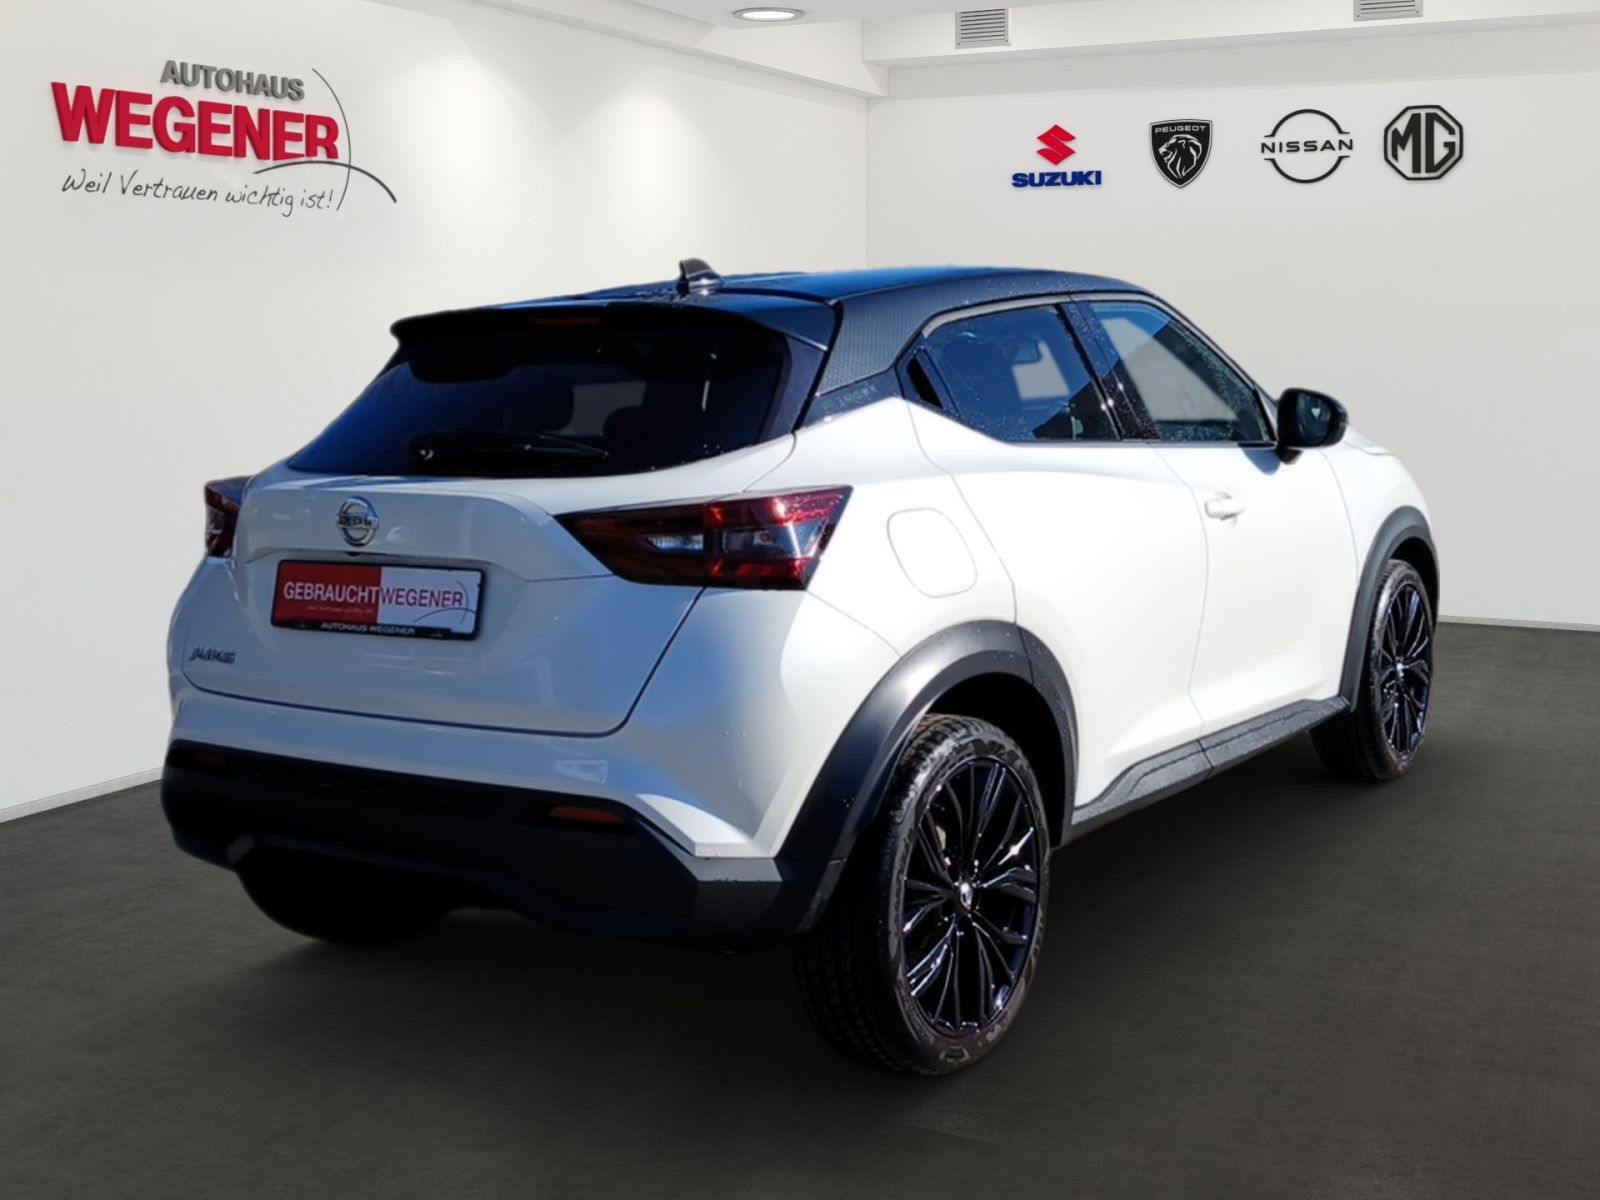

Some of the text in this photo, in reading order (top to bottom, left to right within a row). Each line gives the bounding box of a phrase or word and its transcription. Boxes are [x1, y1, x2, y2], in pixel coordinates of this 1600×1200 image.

[160, 60, 305, 101] AUTOHAUS
[50, 81, 340, 161] WEGENER
[1154, 124, 1207, 133] PEUGEOT
[1261, 138, 1354, 154] NISSAN
[1391, 112, 1456, 174] MG
[62, 168, 112, 194] Weil
[120, 170, 218, 202] Vertrauen
[225, 184, 294, 217] wichtig
[1012, 170, 1103, 188] SUZUKI
[321, 622, 415, 635] AUTOHAUS WEGENER
